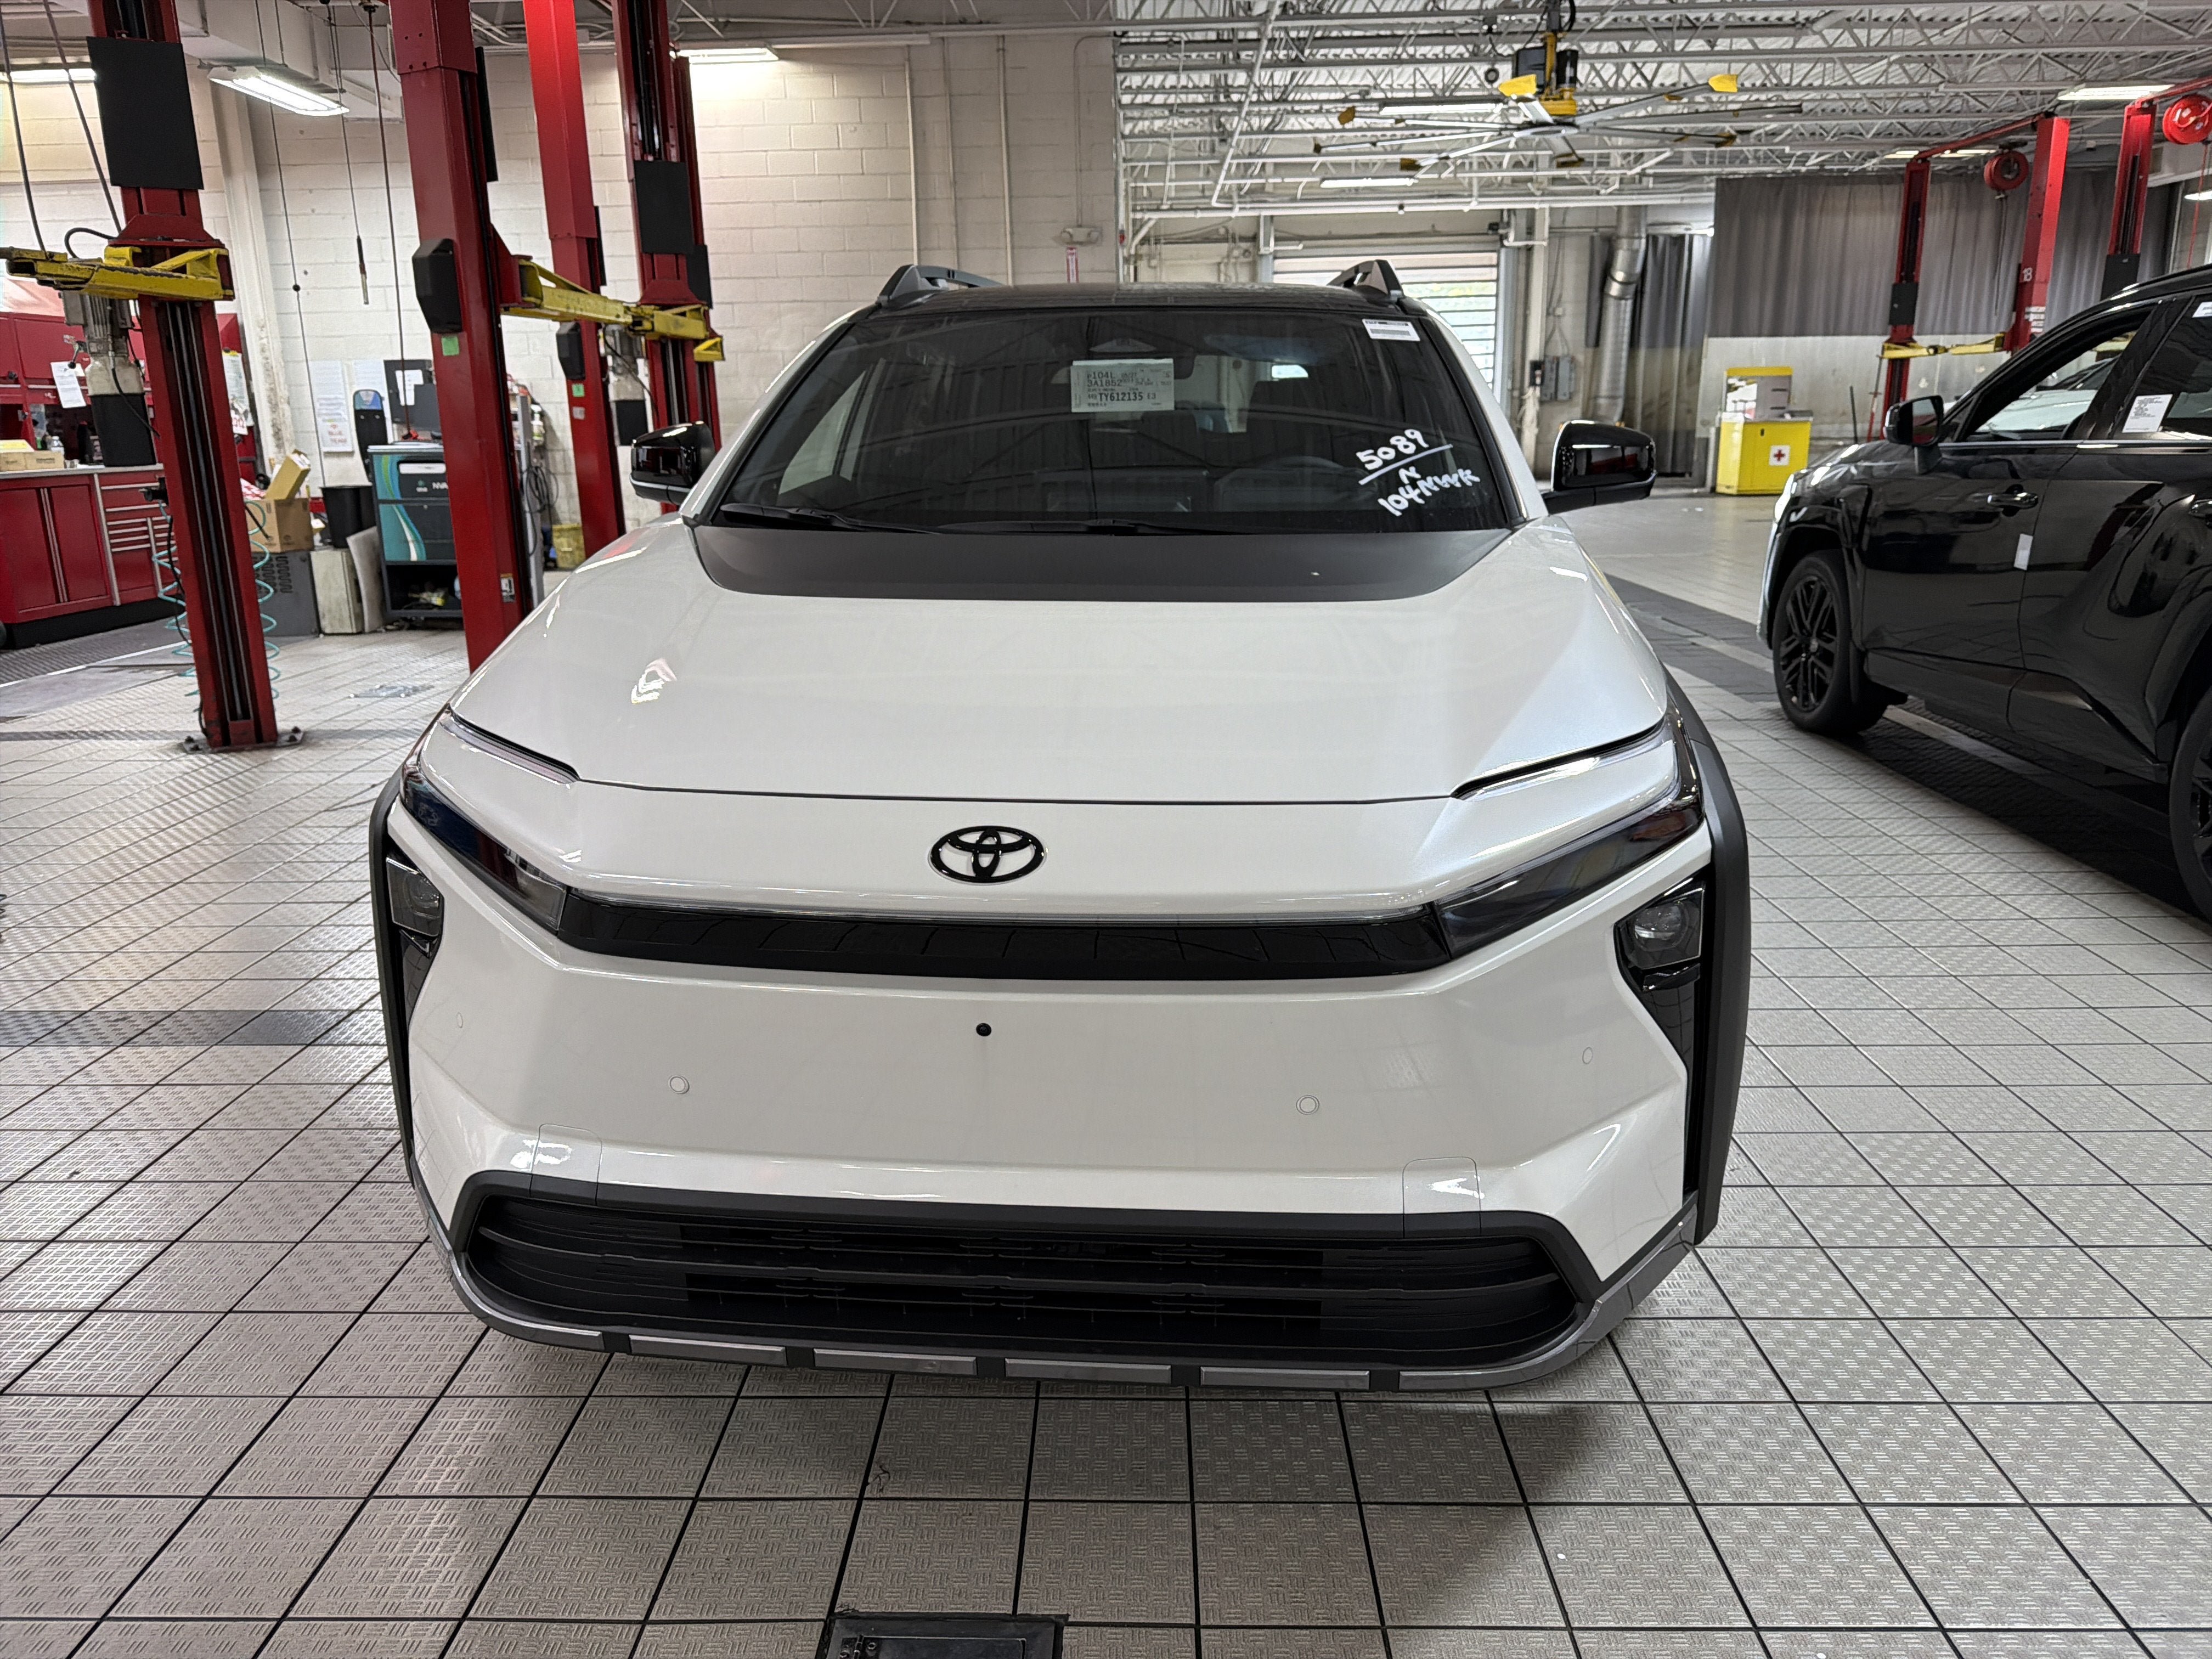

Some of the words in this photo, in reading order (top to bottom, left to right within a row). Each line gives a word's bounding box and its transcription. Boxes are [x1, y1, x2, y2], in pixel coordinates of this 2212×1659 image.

[2023, 267, 2033, 282] 18
[1099, 392, 1143, 402] TY612135
[1356, 428, 1429, 470] 5089
